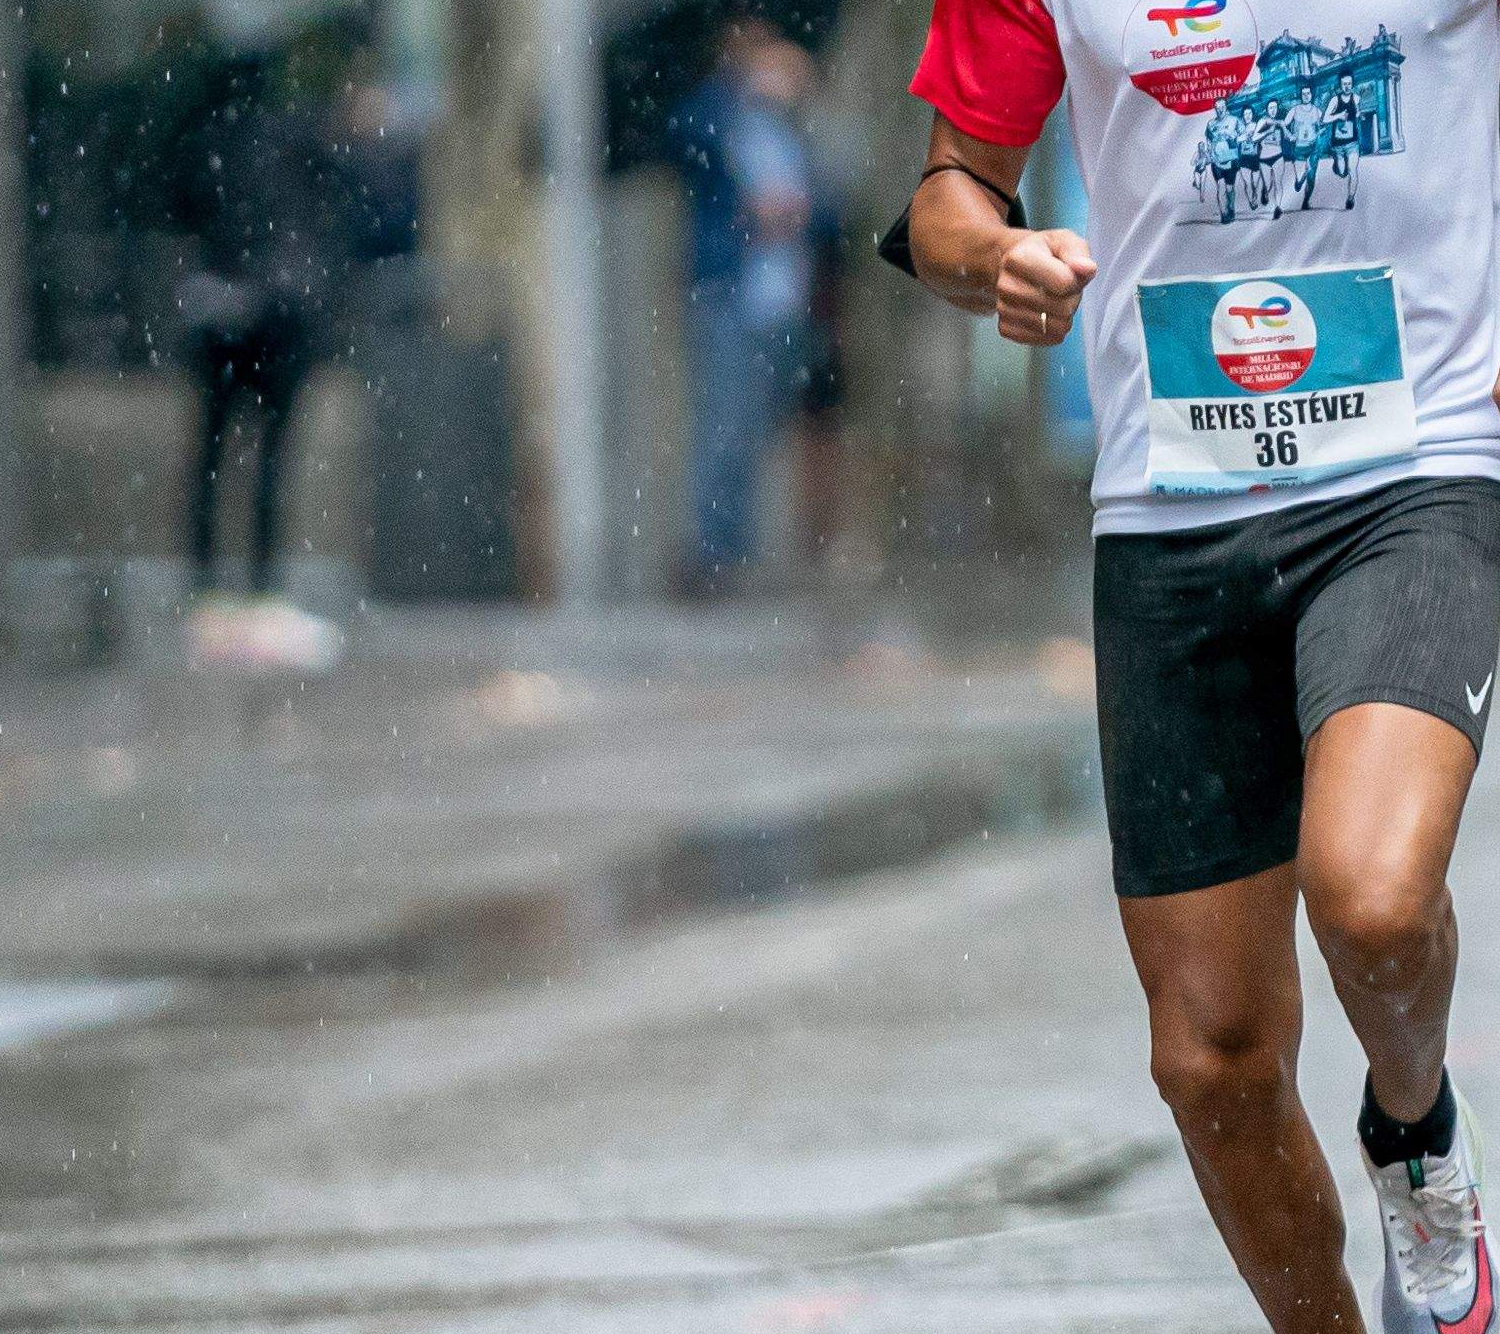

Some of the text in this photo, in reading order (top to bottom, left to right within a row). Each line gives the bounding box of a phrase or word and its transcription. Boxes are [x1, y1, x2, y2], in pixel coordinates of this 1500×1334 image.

[1150, 38, 1231, 59] TotalEnergies
[1173, 67, 1209, 80] MILLA
[1233, 334, 1295, 345] TotalEnergies
[1249, 354, 1280, 363] MILLA
[1229, 361, 1303, 374] INTERNACIONAL
[1241, 371, 1293, 383] DE MADRID
[1189, 392, 1367, 431] REYES ESTÉVEZ
[1254, 430, 1299, 467] 36
